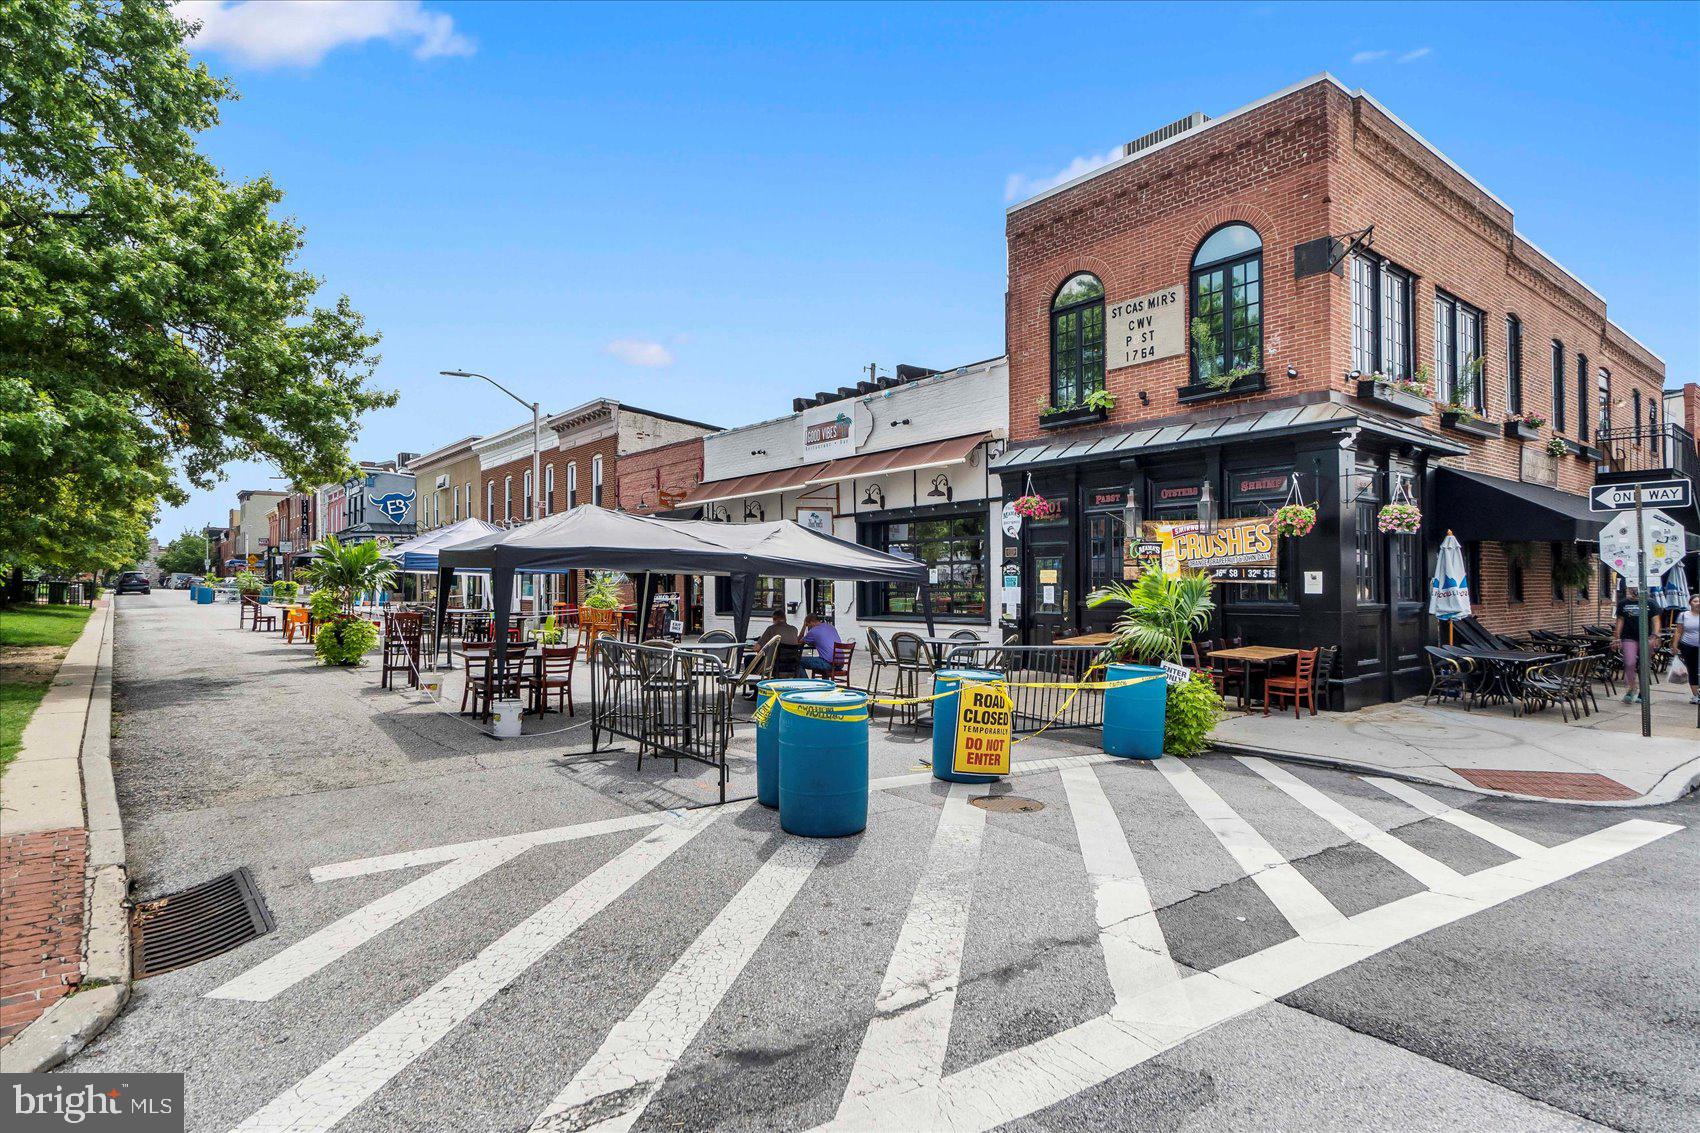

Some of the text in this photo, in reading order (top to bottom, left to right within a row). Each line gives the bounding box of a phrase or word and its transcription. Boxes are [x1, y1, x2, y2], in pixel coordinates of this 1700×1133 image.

[1112, 306, 1122, 318] ST
[1126, 346, 1155, 362] 1764
[1096, 494, 1120, 504] PABST
[1161, 487, 1198, 498] OYSTERS
[1613, 489, 1679, 503] ON WAY
[387, 499, 406, 515] EB
[1173, 523, 1272, 561] CRUSHES
[1229, 568, 1238, 577] $8
[1263, 569, 1276, 578] $15
[973, 692, 1005, 709] ROAD
[963, 708, 1009, 726] CLOSED
[963, 725, 1008, 735] TEMPORARILY
[965, 737, 1005, 752] DO NOT
[966, 752, 1001, 766] ENTER
